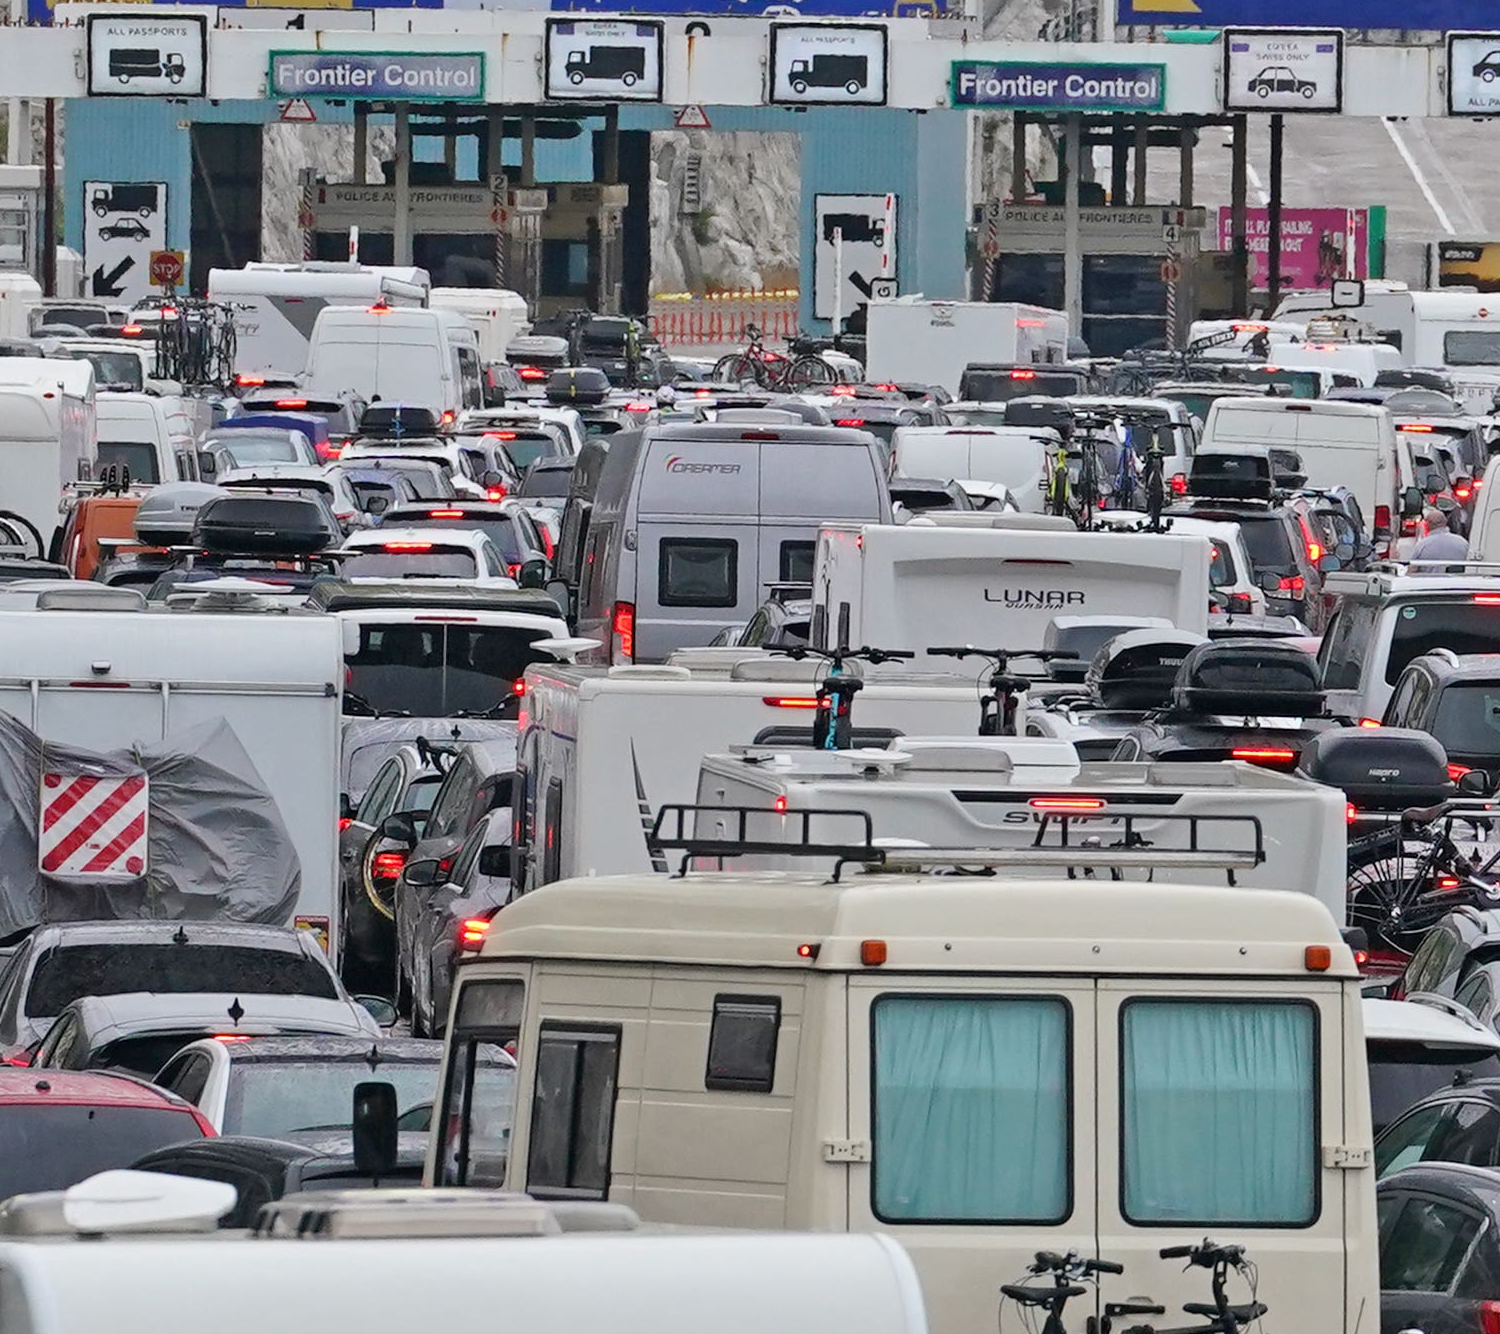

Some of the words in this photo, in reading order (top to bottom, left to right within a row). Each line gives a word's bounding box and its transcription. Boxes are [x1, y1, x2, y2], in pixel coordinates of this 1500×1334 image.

[279, 64, 375, 87] Frontier
[383, 65, 476, 87] Control
[959, 74, 1060, 98] Frontier
[1064, 75, 1156, 98] Control
[491, 176, 504, 190] 2
[988, 203, 999, 218] 3
[1005, 212, 1048, 223] POLICE
[1163, 228, 1176, 241] 4
[152, 263, 183, 278] STOP
[984, 588, 1086, 605] LUNAR
